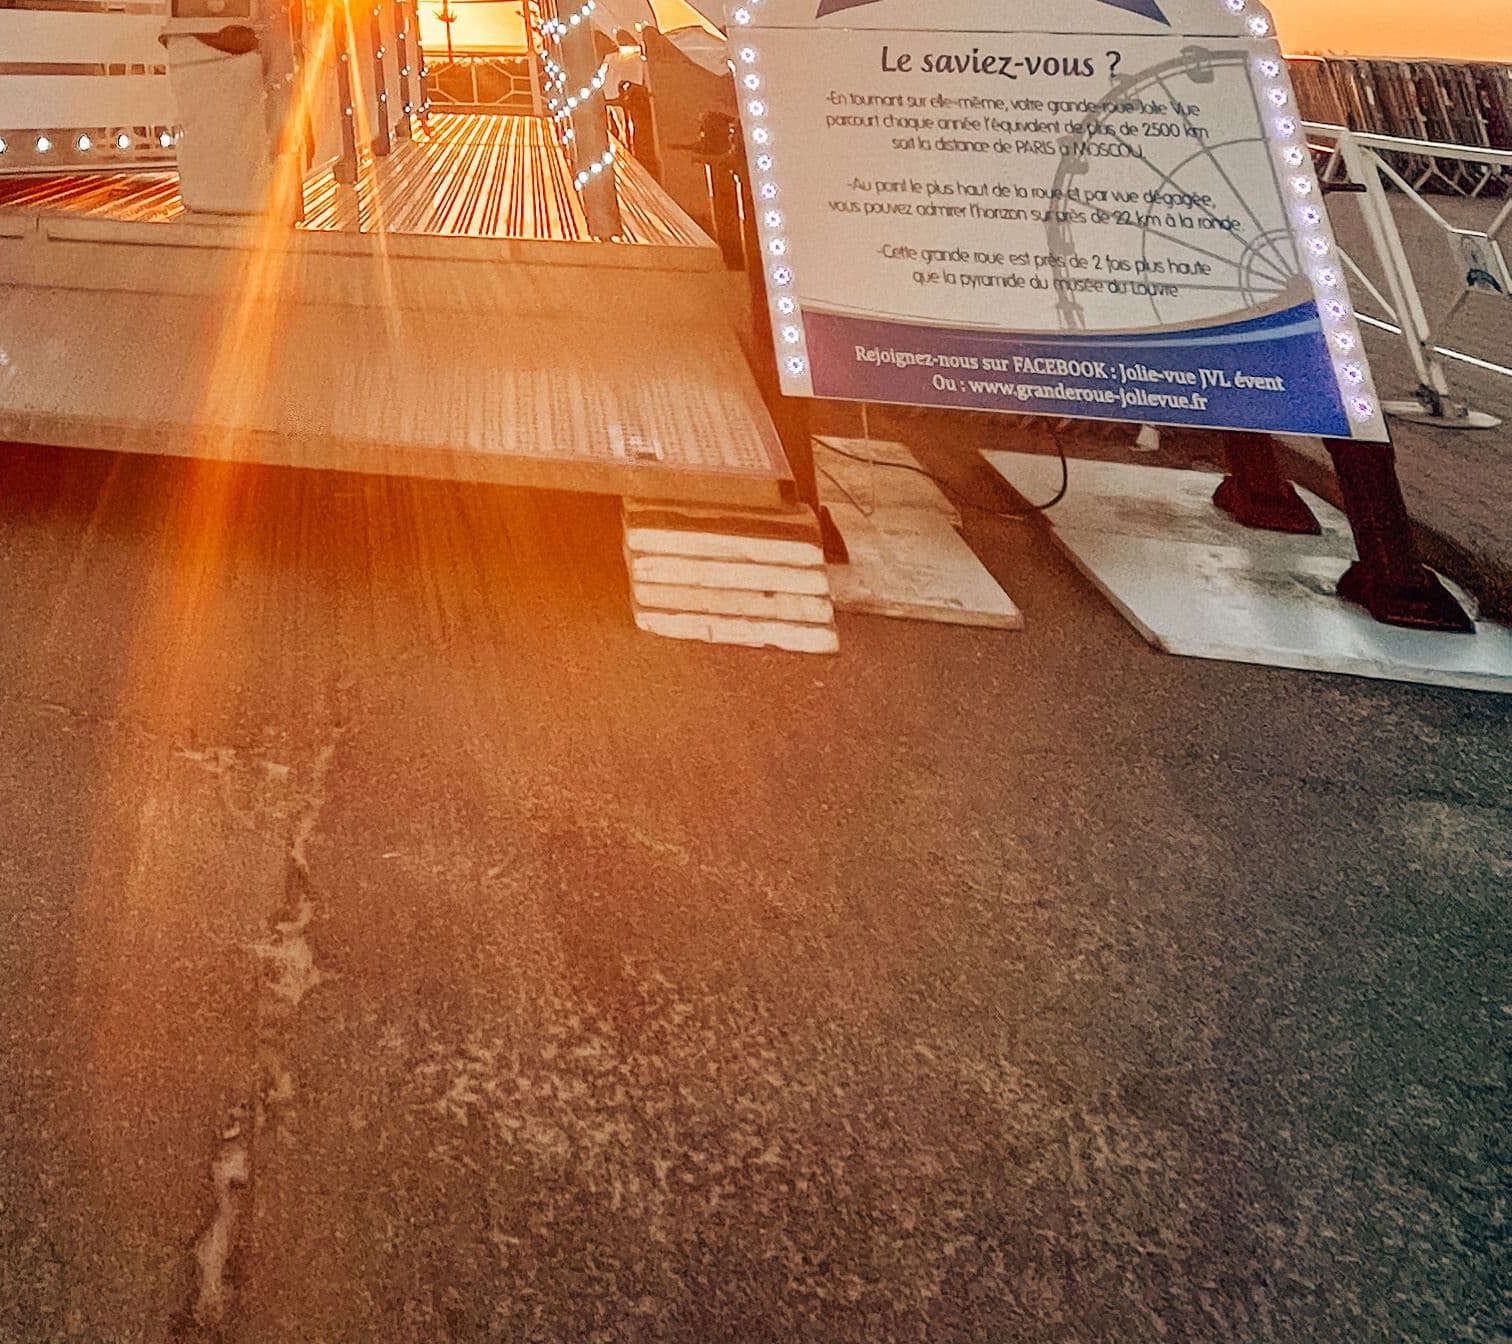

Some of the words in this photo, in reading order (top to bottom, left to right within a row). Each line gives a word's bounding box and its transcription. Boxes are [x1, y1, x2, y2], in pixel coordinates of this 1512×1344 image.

[881, 46, 912, 72] Le
[920, 47, 1095, 80] saviez-vous
[1105, 51, 1121, 78] ?
[849, 93, 903, 106] tournant
[907, 95, 926, 109] sur
[1011, 98, 1044, 111] votre
[1170, 101, 1200, 117] Vue
[826, 114, 880, 129] parcourt
[883, 114, 934, 131] chaque
[938, 117, 981, 131] année
[1064, 121, 1084, 134] de
[1087, 120, 1116, 138] plus
[1120, 121, 1138, 136] de
[1142, 122, 1180, 137] 2500
[1184, 124, 1209, 139] km
[892, 136, 915, 150] soit
[918, 137, 931, 150] la
[935, 136, 989, 152] distance
[993, 138, 1012, 153] de
[1016, 140, 1056, 154] PARIS
[875, 178, 906, 194] point
[910, 178, 922, 193] le
[926, 180, 954, 197] plus
[957, 180, 988, 196] haut
[992, 182, 1011, 197] de
[1014, 183, 1027, 198] la
[1032, 187, 1063, 200] roue
[1067, 186, 1080, 201] et
[1084, 190, 1108, 207] par
[1113, 191, 1138, 203] vue
[828, 200, 860, 213] vous
[864, 201, 912, 216] pouvez
[916, 202, 966, 217] admirer
[1031, 208, 1051, 222] sur
[1090, 209, 1110, 225] de
[1112, 210, 1131, 226] 22
[1138, 210, 1162, 228] km
[1180, 214, 1194, 229] la
[921, 247, 970, 264] grande
[974, 249, 1005, 263] roue
[1009, 251, 1030, 266] est
[1035, 253, 1066, 269] près
[1069, 254, 1089, 268] de
[1092, 255, 1102, 270] 2
[1105, 255, 1132, 274] fois
[1135, 256, 1165, 275] plus
[1168, 260, 1212, 275] haute
[912, 270, 939, 286] que
[943, 269, 956, 284] la
[960, 272, 1025, 289] pyramide
[1029, 275, 1048, 290] du
[1107, 280, 1127, 294] du
[855, 345, 978, 370] Rejoignez-nous
[982, 355, 1009, 370] sur
[1013, 356, 1108, 379] FACEBOOK
[1110, 367, 1117, 379] :
[1119, 363, 1197, 385] Jolie-vue
[1198, 368, 1231, 390] JVL
[1235, 371, 1286, 392] évent
[932, 374, 958, 391] Ou
[968, 380, 1209, 410] www.granderoue-jolievue.fr
